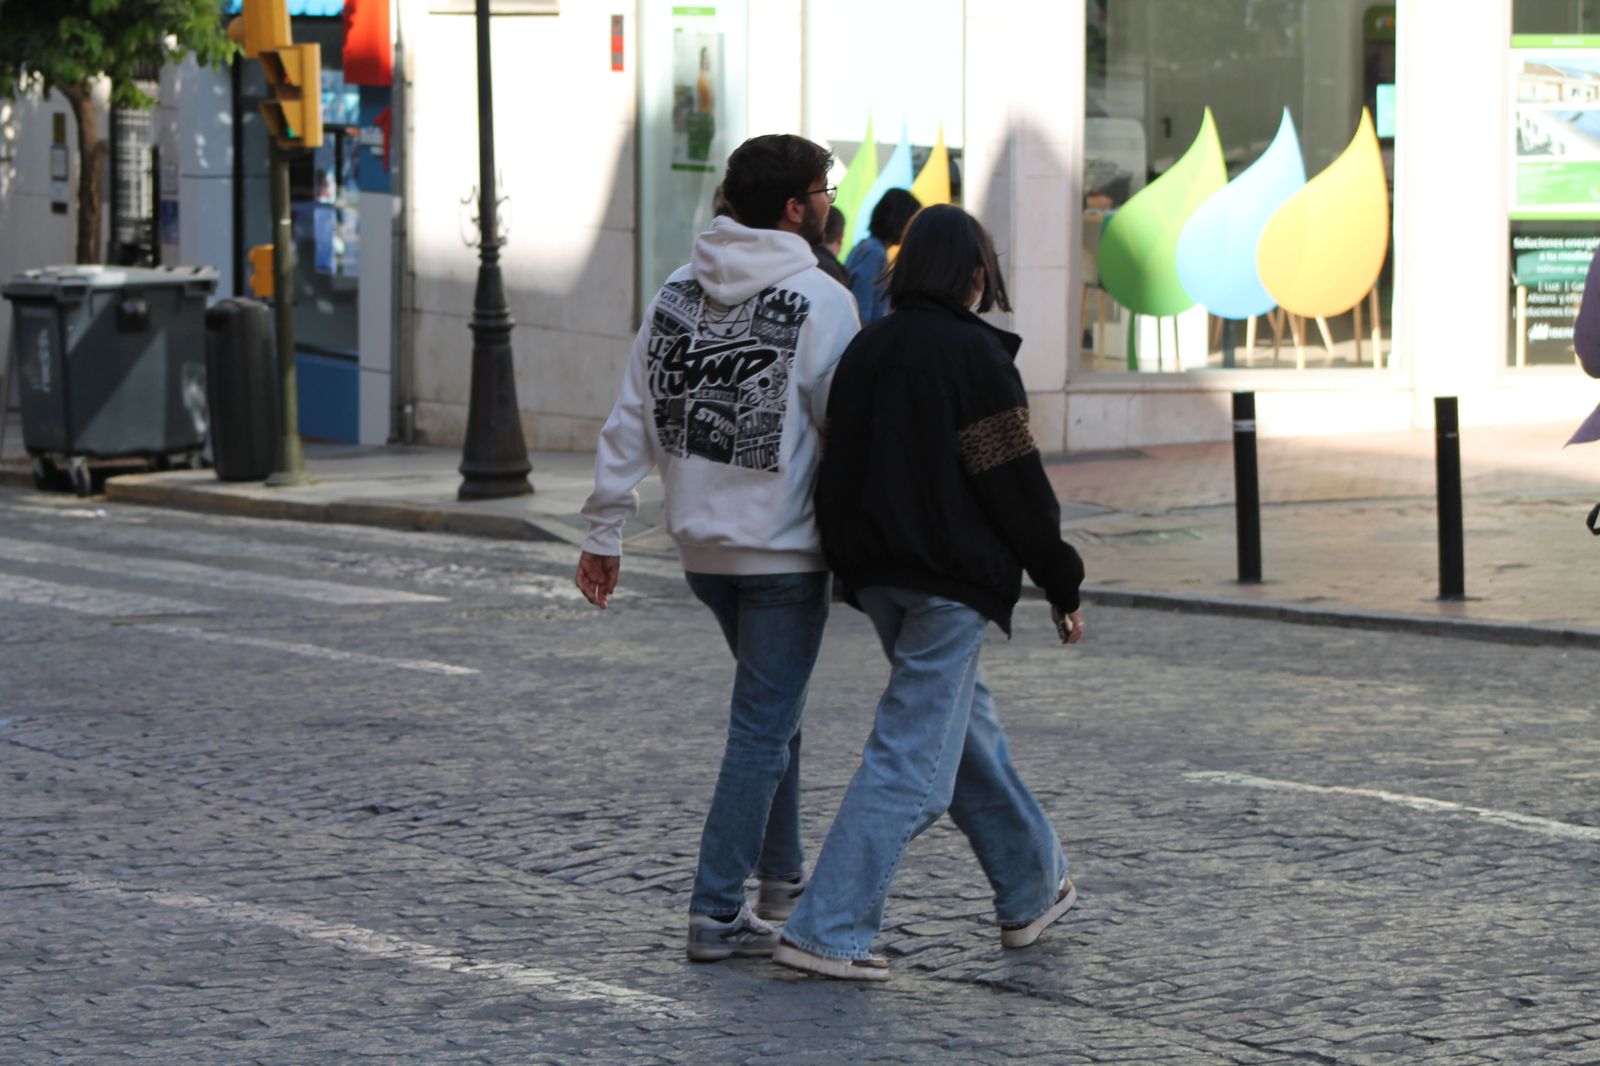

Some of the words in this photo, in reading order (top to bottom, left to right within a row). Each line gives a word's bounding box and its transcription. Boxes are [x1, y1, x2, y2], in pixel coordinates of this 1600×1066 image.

[1513, 237, 1564, 250] Soluciones
[1527, 292, 1557, 304] Ahorro
[694, 388, 736, 402] SERVICE
[695, 407, 736, 436] STWD
[709, 430, 730, 450] OIL
